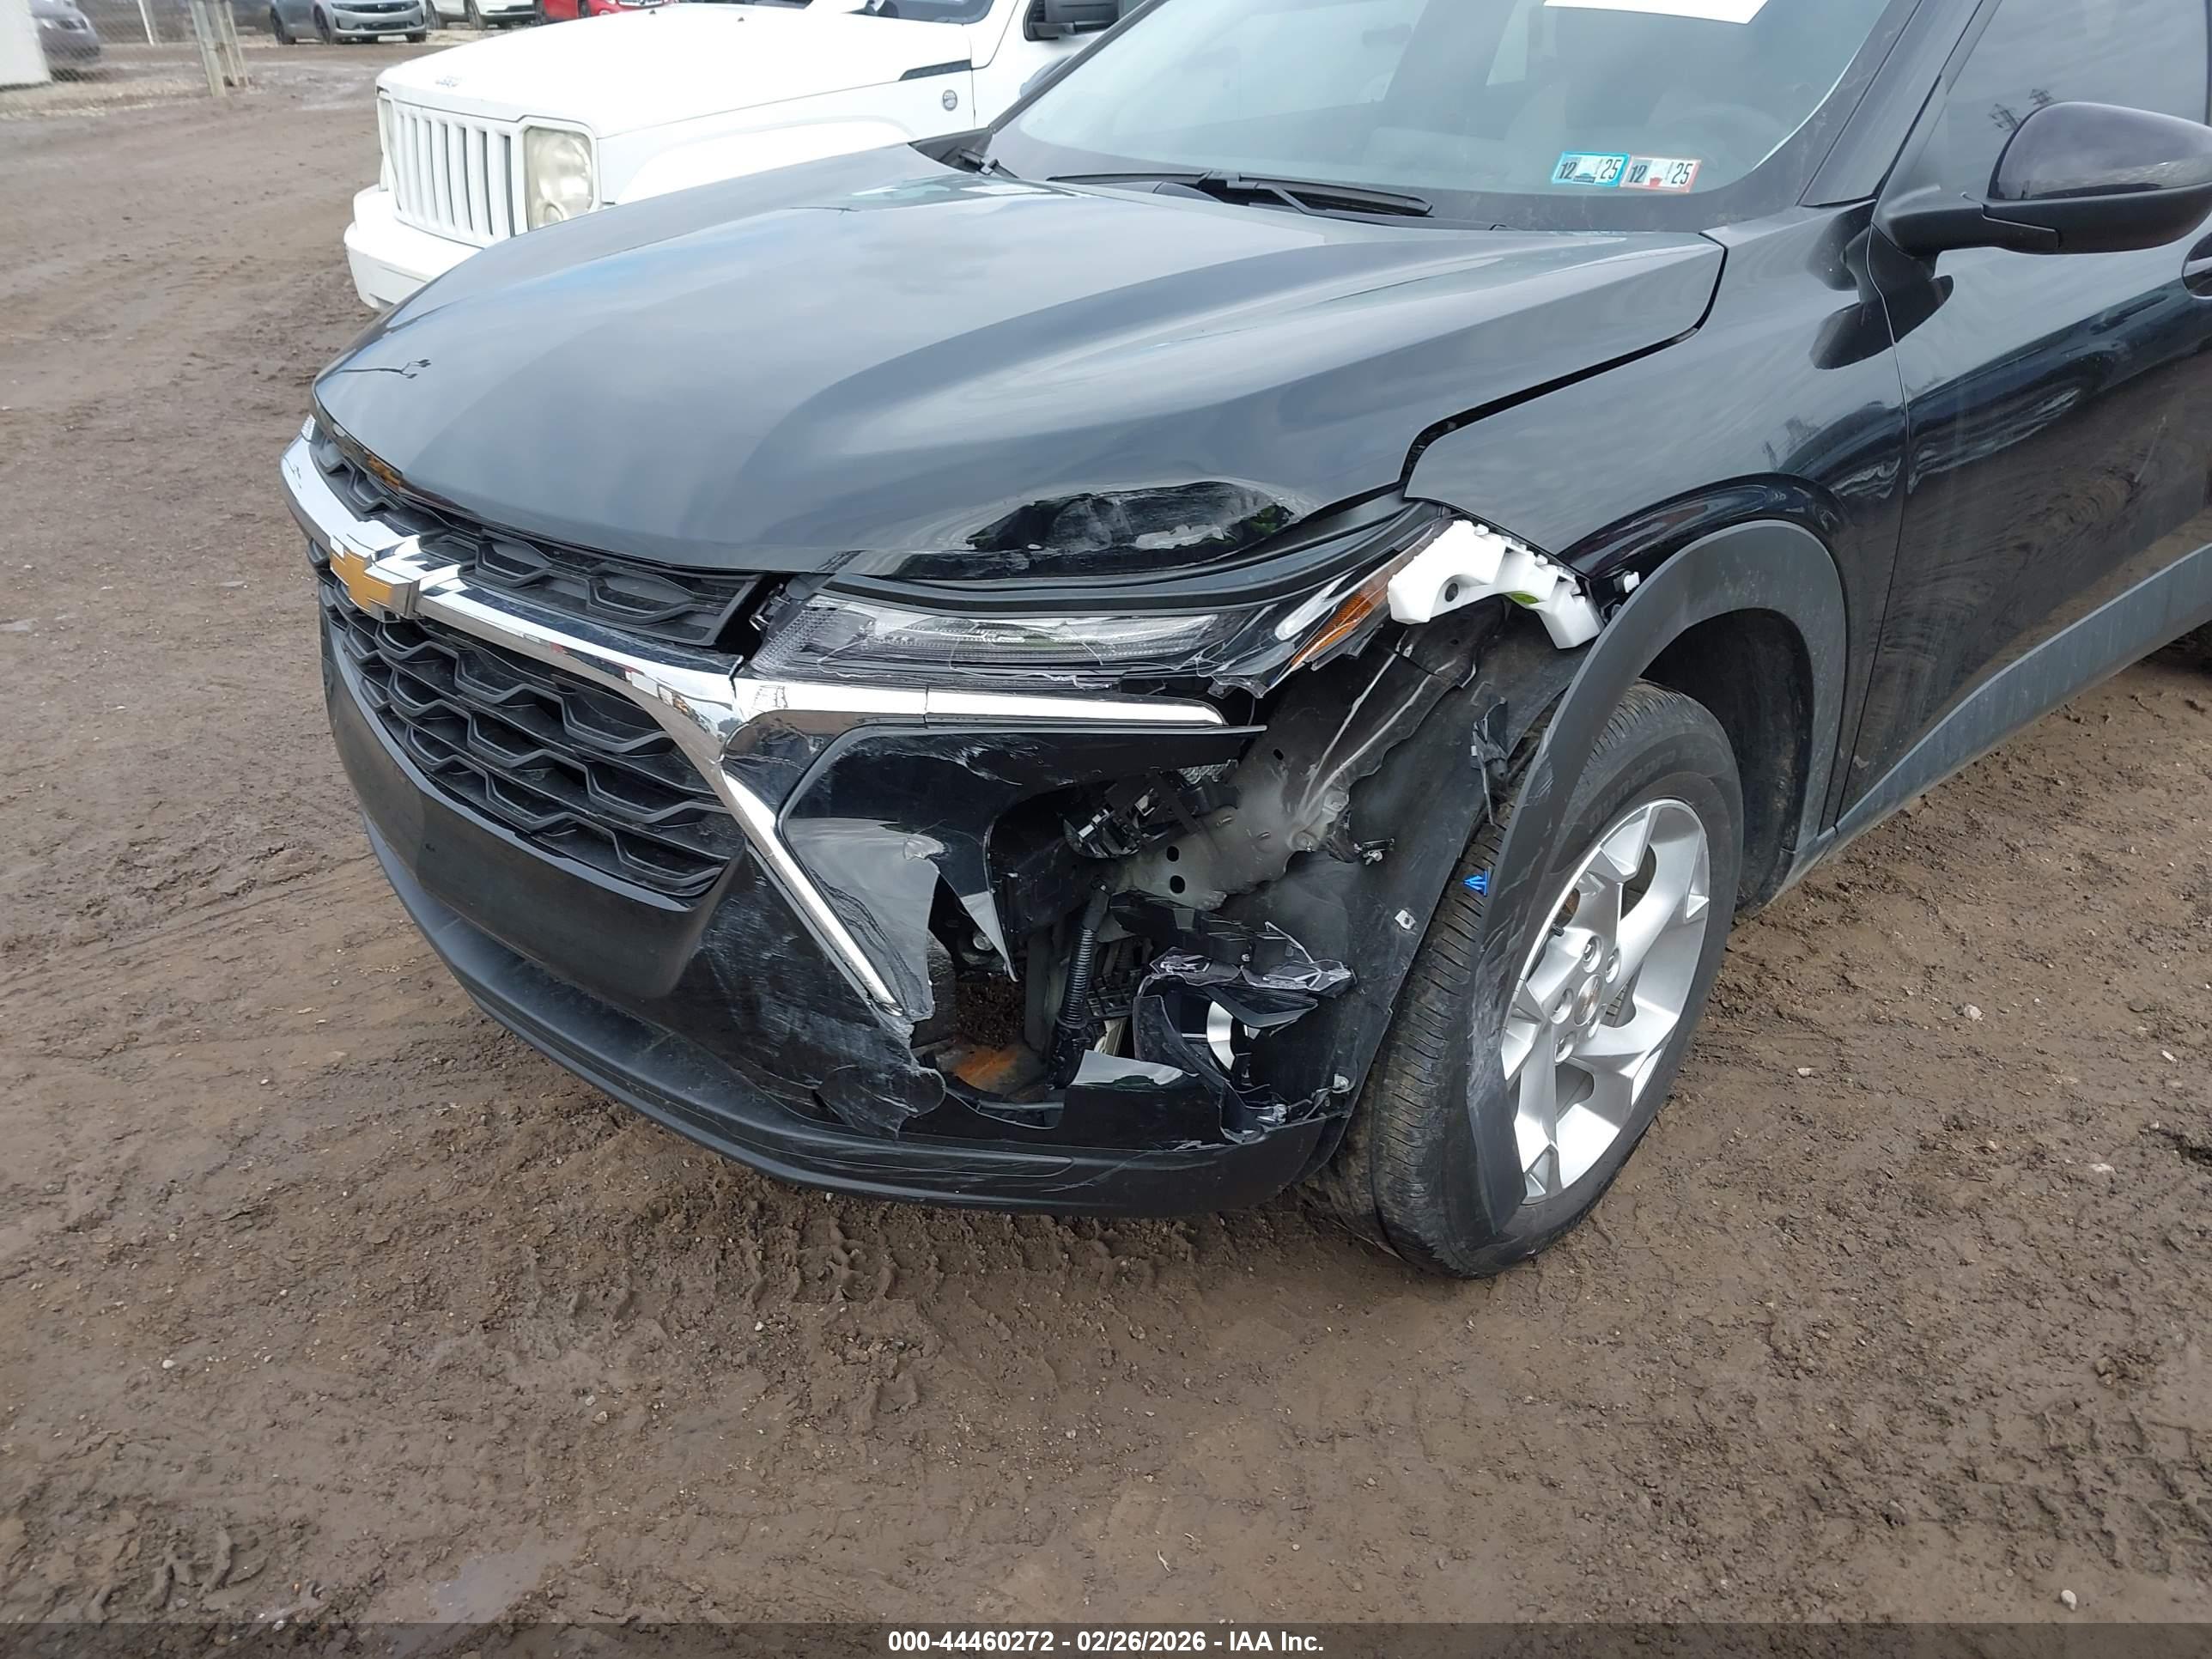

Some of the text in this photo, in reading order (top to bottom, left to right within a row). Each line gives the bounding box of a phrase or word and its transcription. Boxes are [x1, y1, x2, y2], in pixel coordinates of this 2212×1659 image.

[1559, 161, 1577, 179] 12
[1600, 158, 1622, 179] 25
[1629, 161, 1693, 185] 12 25
